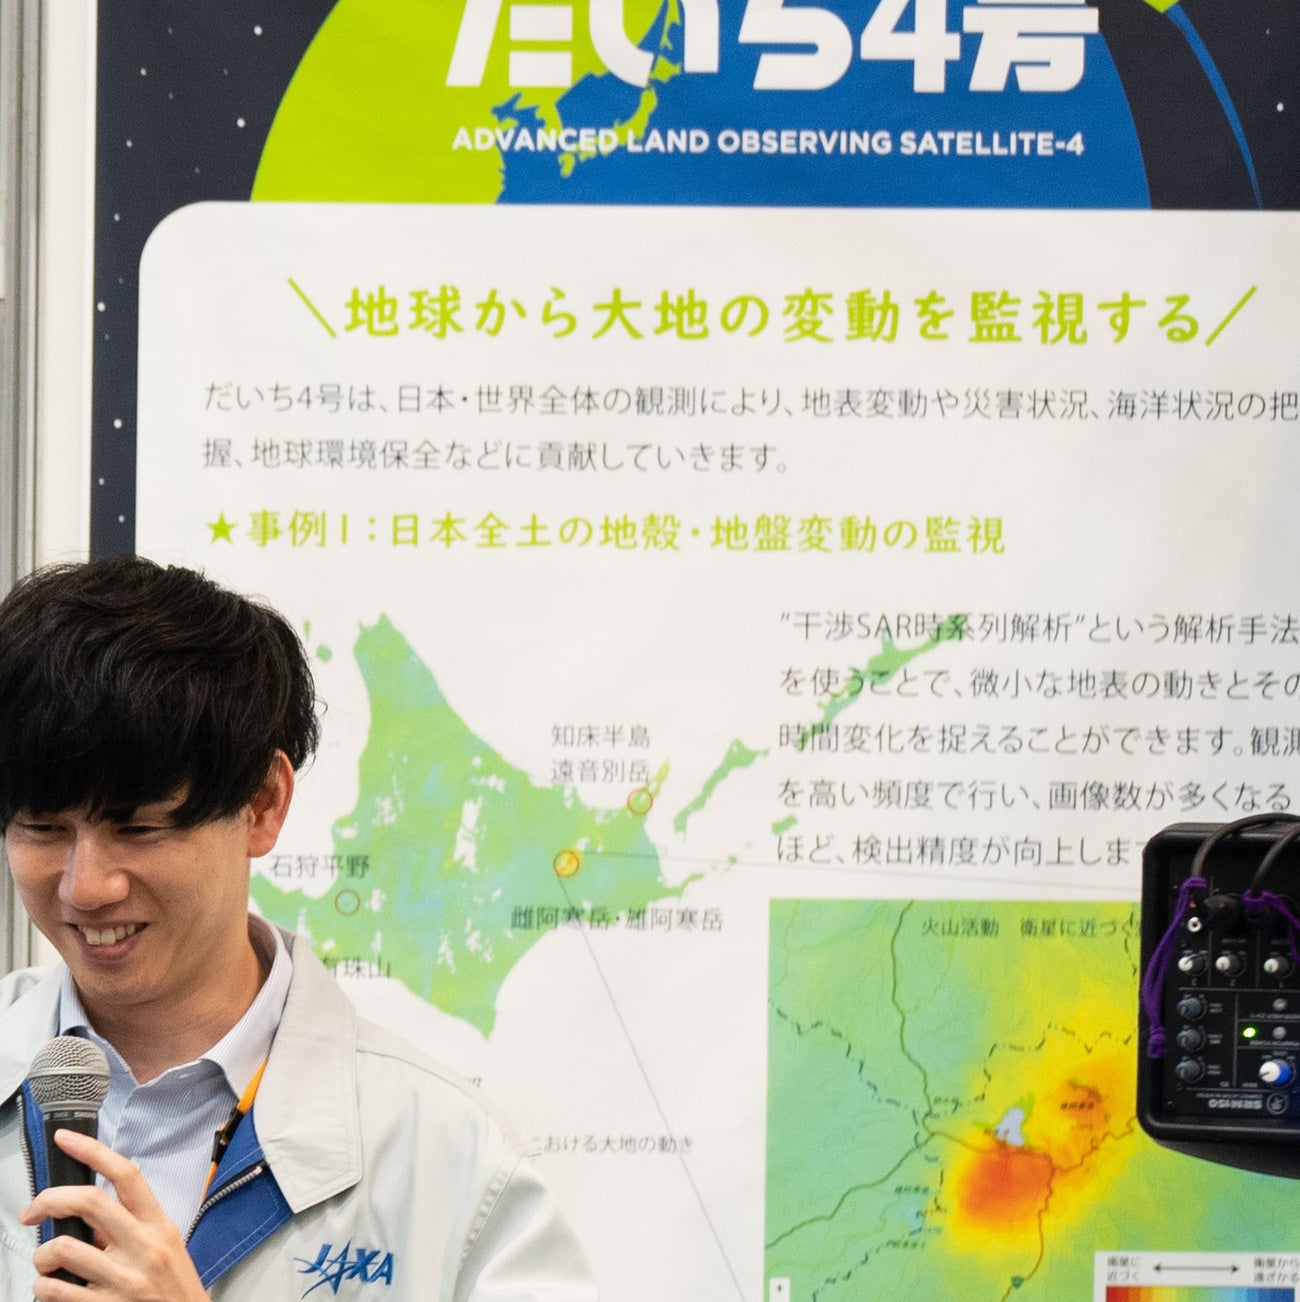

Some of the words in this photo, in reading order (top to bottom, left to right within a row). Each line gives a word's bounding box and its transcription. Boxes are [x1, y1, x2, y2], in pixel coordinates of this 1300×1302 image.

[452, 127, 619, 154] ADVANCED
[626, 129, 710, 154] LAND
[717, 129, 893, 156] OBSERVING
[899, 132, 1085, 157] SATELLITE-4
[343, 284, 1200, 345] 地球から大地の変動を監視する
[202, 438, 788, 475] 握、地球環境保全などに貢献していきます。
[550, 724, 651, 749] 知床半島
[779, 779, 1291, 812] を高い頻度で行い、画像数が多くなる
[271, 853, 370, 879] 石狩平野
[777, 836, 1146, 867] ほど、検出精度が向上しま
[293, 1239, 394, 1300] JAXA
